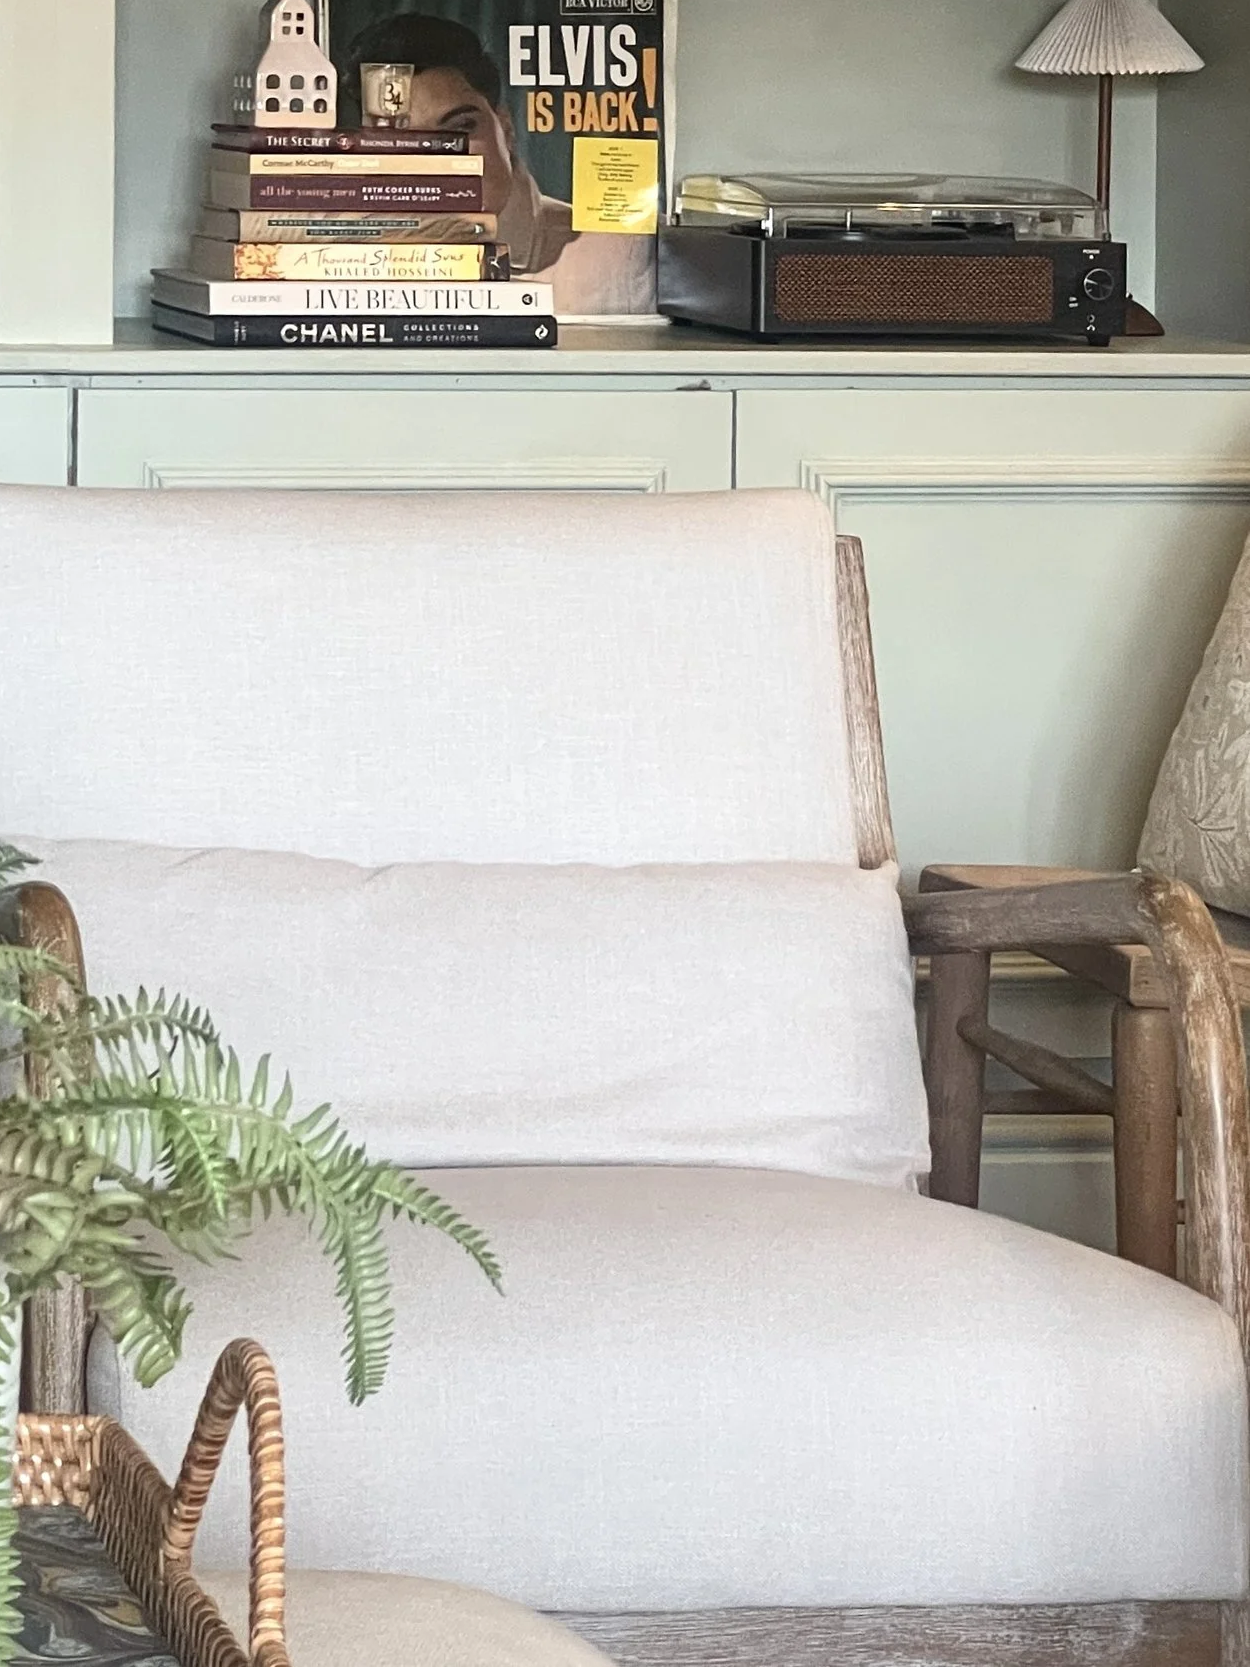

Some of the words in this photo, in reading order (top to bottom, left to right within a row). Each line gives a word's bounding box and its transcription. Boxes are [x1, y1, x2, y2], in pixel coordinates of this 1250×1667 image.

[509, 24, 638, 87] ELVIS
[527, 91, 555, 133] IS
[266, 135, 288, 147] THE
[291, 135, 332, 148] SECRET
[359, 139, 394, 149] RHONDA
[396, 139, 420, 149] BYRNE
[262, 158, 294, 169] Cormac
[295, 157, 335, 170] McCarthy
[259, 186, 275, 197] all
[276, 186, 296, 197] the
[296, 187, 331, 200] young
[332, 189, 357, 197] men
[362, 186, 384, 195] RUTH
[384, 186, 414, 195] COKER
[293, 251, 308, 267] A
[316, 247, 367, 267] Thousand
[370, 248, 427, 268] Splendid
[431, 247, 466, 264] Suns
[324, 267, 380, 277] KHALED
[387, 267, 454, 277] HOSSEINI
[305, 289, 359, 310] LIVE
[366, 288, 500, 310] BEAUTIFUL
[279, 322, 394, 344] CHANEL
[402, 323, 480, 332] COLLECTIONS
[402, 334, 423, 343] AND
[424, 334, 480, 343] CREATIONS
